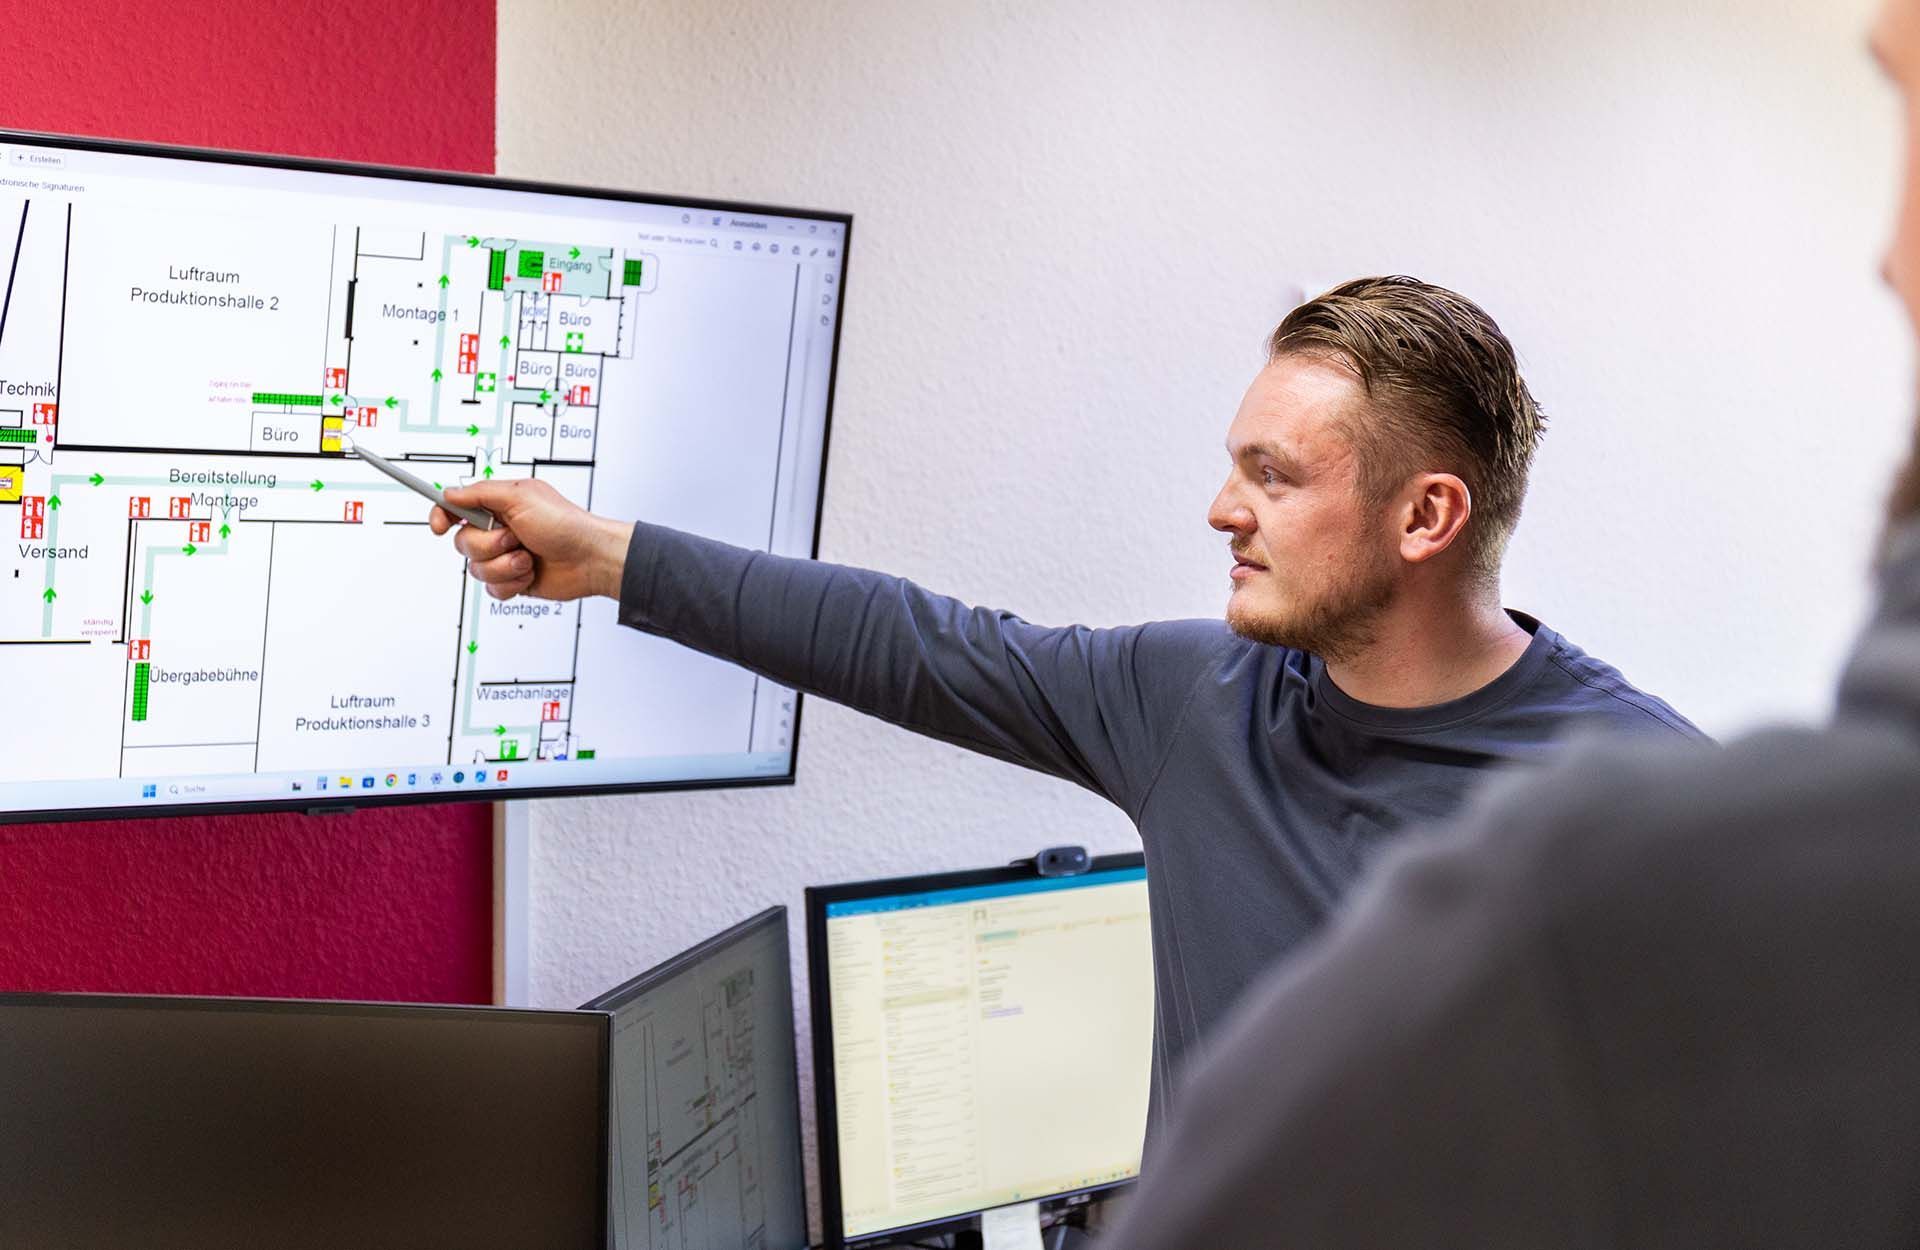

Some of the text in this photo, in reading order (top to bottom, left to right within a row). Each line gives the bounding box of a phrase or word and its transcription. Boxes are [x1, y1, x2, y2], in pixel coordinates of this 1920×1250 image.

[731, 219, 767, 230] Anmelden
[169, 266, 241, 284] Luftraum
[549, 258, 593, 275] Eingang
[130, 287, 280, 311] Produktionshalle 2
[383, 304, 446, 323] Montage
[559, 310, 592, 327] Büro
[520, 360, 553, 377] Büro
[565, 364, 597, 380] Büro
[0, 379, 56, 397] Technik
[262, 427, 299, 443] Büro
[514, 423, 547, 440] Büro
[559, 424, 592, 440] Büro
[169, 469, 277, 488] Bereitstellung
[190, 492, 259, 509] Montage
[18, 544, 89, 561] Versand
[490, 602, 562, 619] Montage 2
[150, 667, 258, 685] Übergabebühne
[330, 695, 396, 709] Luftraum
[476, 686, 569, 702] Waschanlage
[295, 714, 431, 732] Produktionshalle 3
